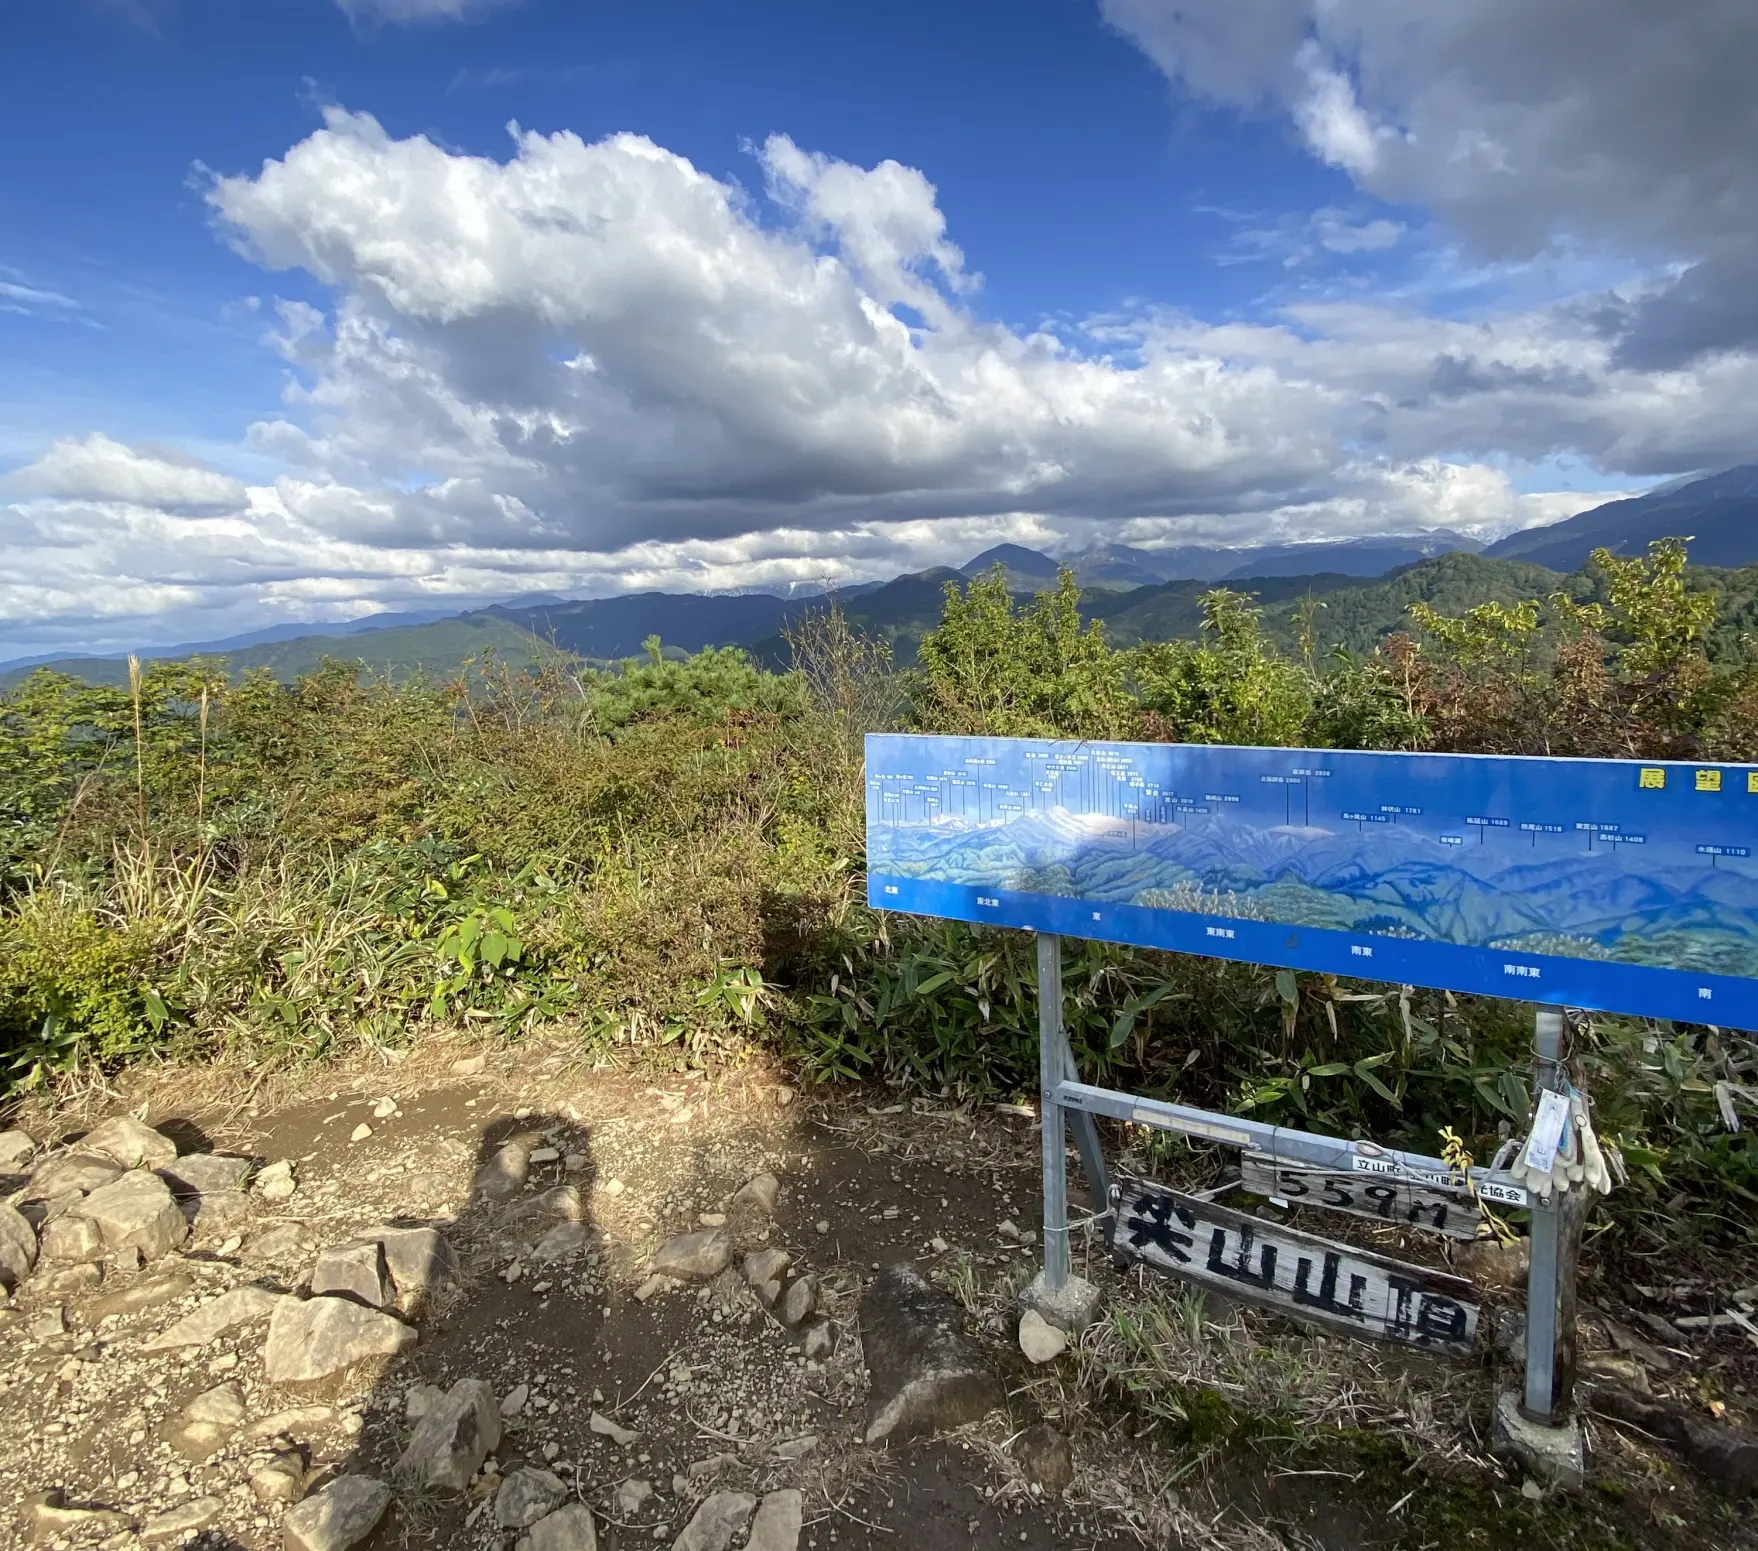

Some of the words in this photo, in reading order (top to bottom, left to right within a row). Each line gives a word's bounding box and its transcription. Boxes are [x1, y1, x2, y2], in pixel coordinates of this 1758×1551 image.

[884, 885, 899, 895] 北東
[976, 896, 1000, 908] 東北東
[1092, 912, 1101, 921] 東
[1206, 926, 1236, 940] 東南東
[1351, 945, 1373, 957] 南東
[1503, 964, 1541, 979] 南南東
[1698, 987, 1712, 1000] 南
